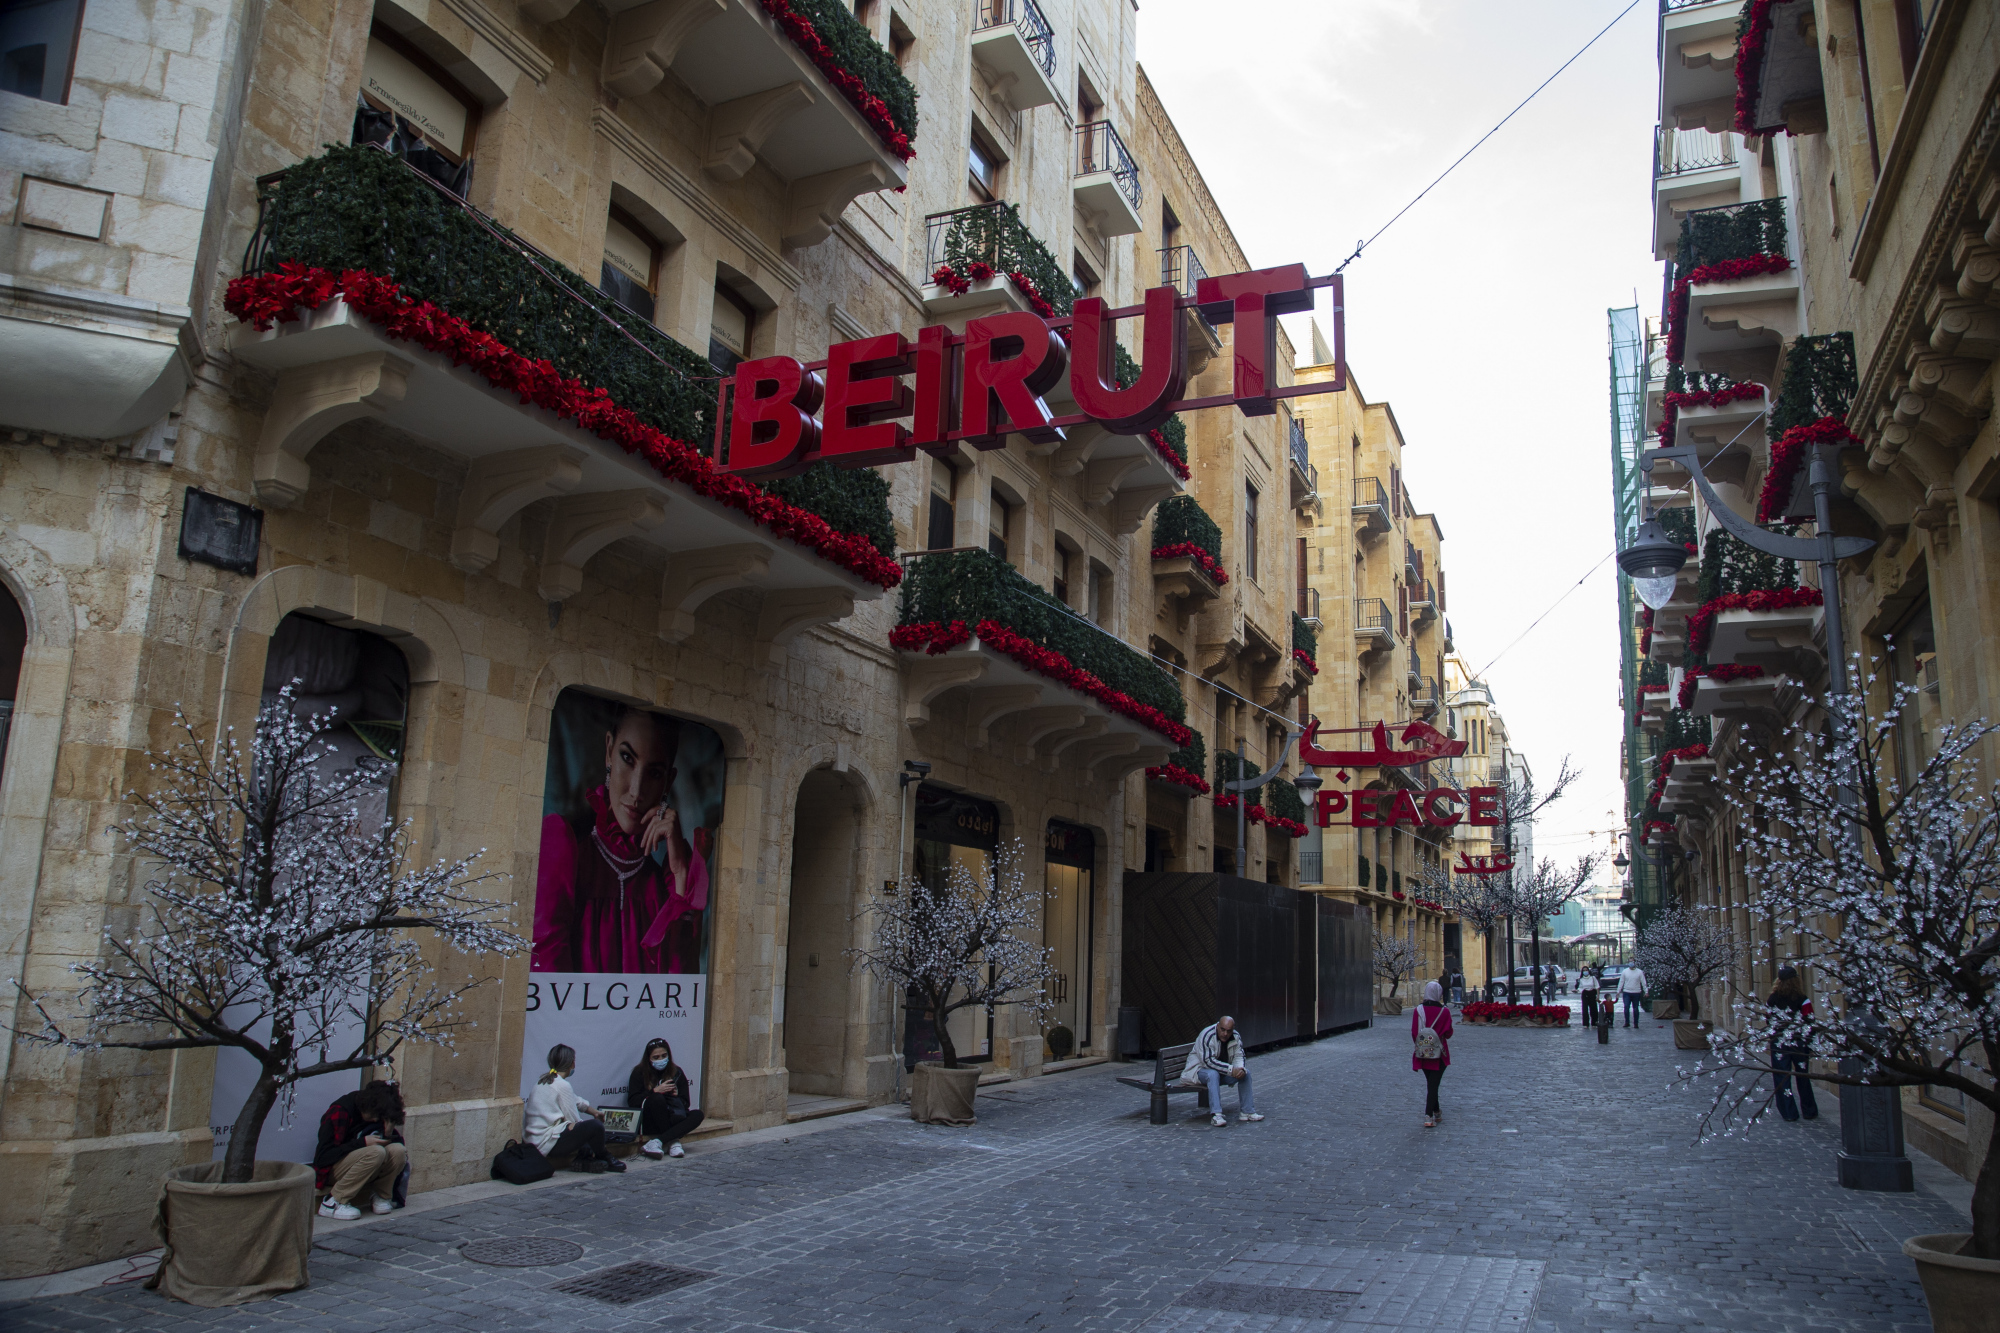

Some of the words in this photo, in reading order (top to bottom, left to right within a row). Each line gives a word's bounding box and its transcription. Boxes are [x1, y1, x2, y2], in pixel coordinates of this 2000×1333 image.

[368, 77, 420, 122] Ermenegildo
[420, 115, 445, 140] Zegna
[729, 263, 1313, 478] BEIRUT
[1300, 718, 1469, 784] حب
[1318, 786, 1500, 828] PEACE
[1454, 851, 1516, 880] عيد
[526, 982, 700, 1012] BVLGARI
[658, 1010, 688, 1019] ROMA
